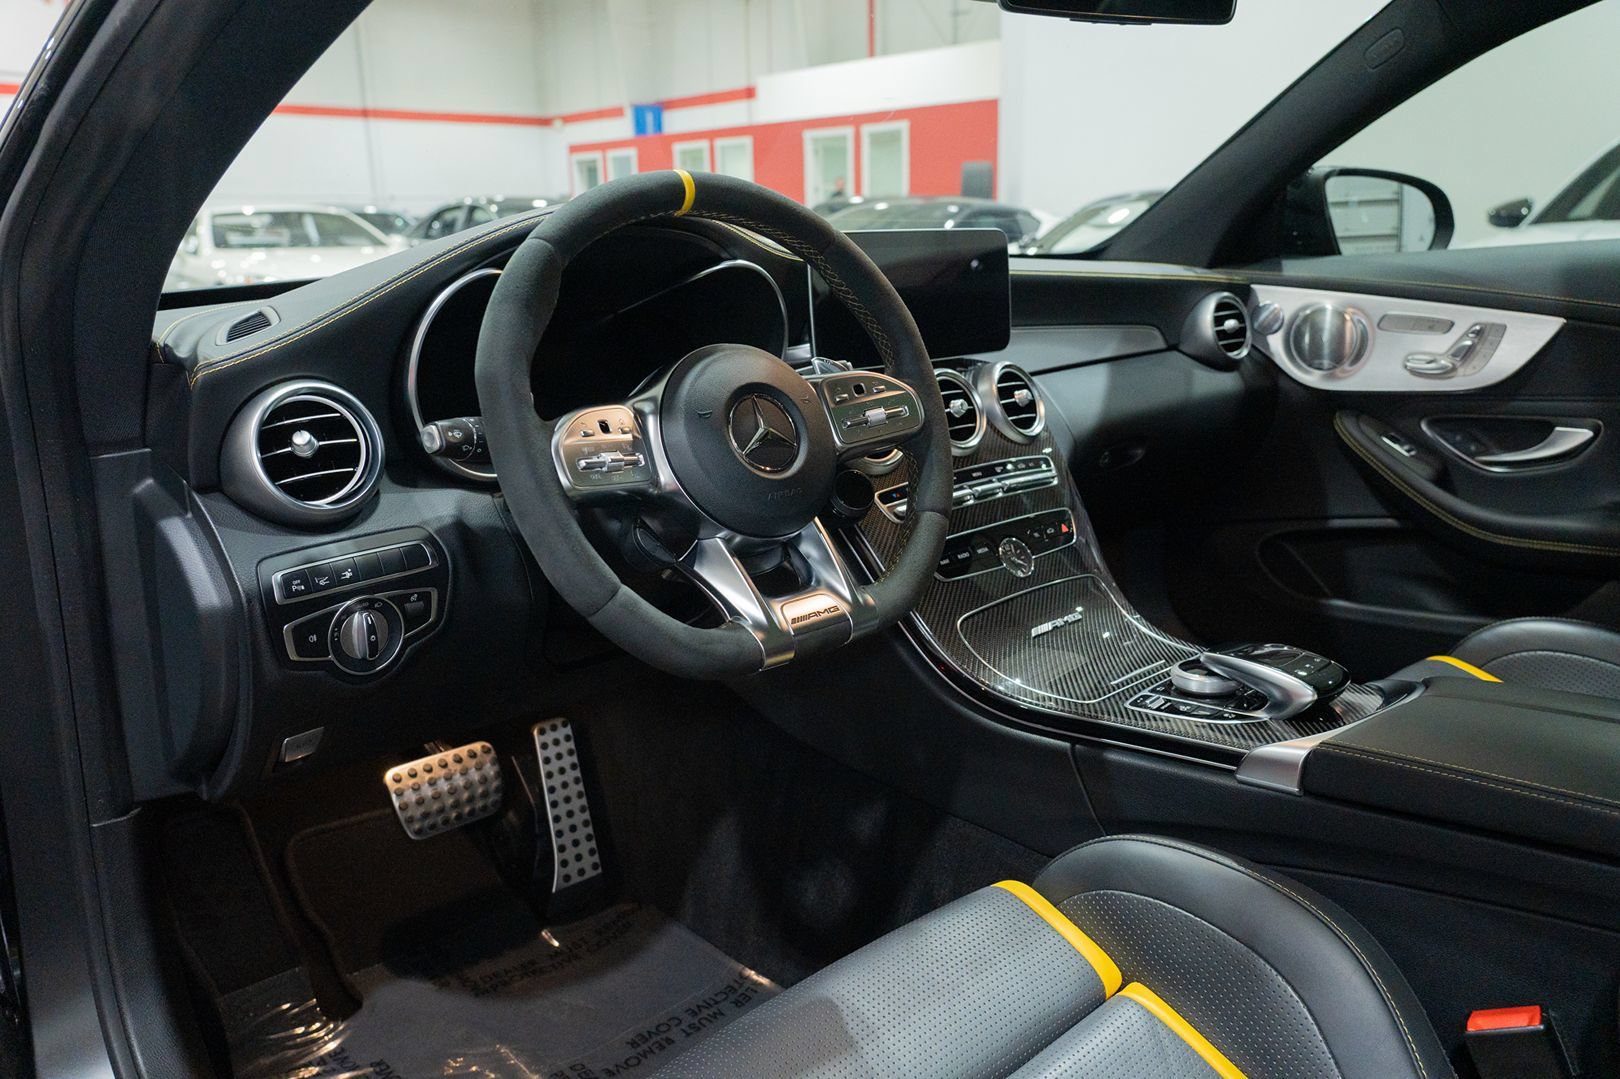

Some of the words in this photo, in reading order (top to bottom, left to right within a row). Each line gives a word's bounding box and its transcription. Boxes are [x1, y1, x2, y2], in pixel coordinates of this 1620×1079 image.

[625, 1017, 682, 1049] COVER
[681, 1009, 725, 1037] MUST
[601, 1036, 675, 1077] REMOVE
